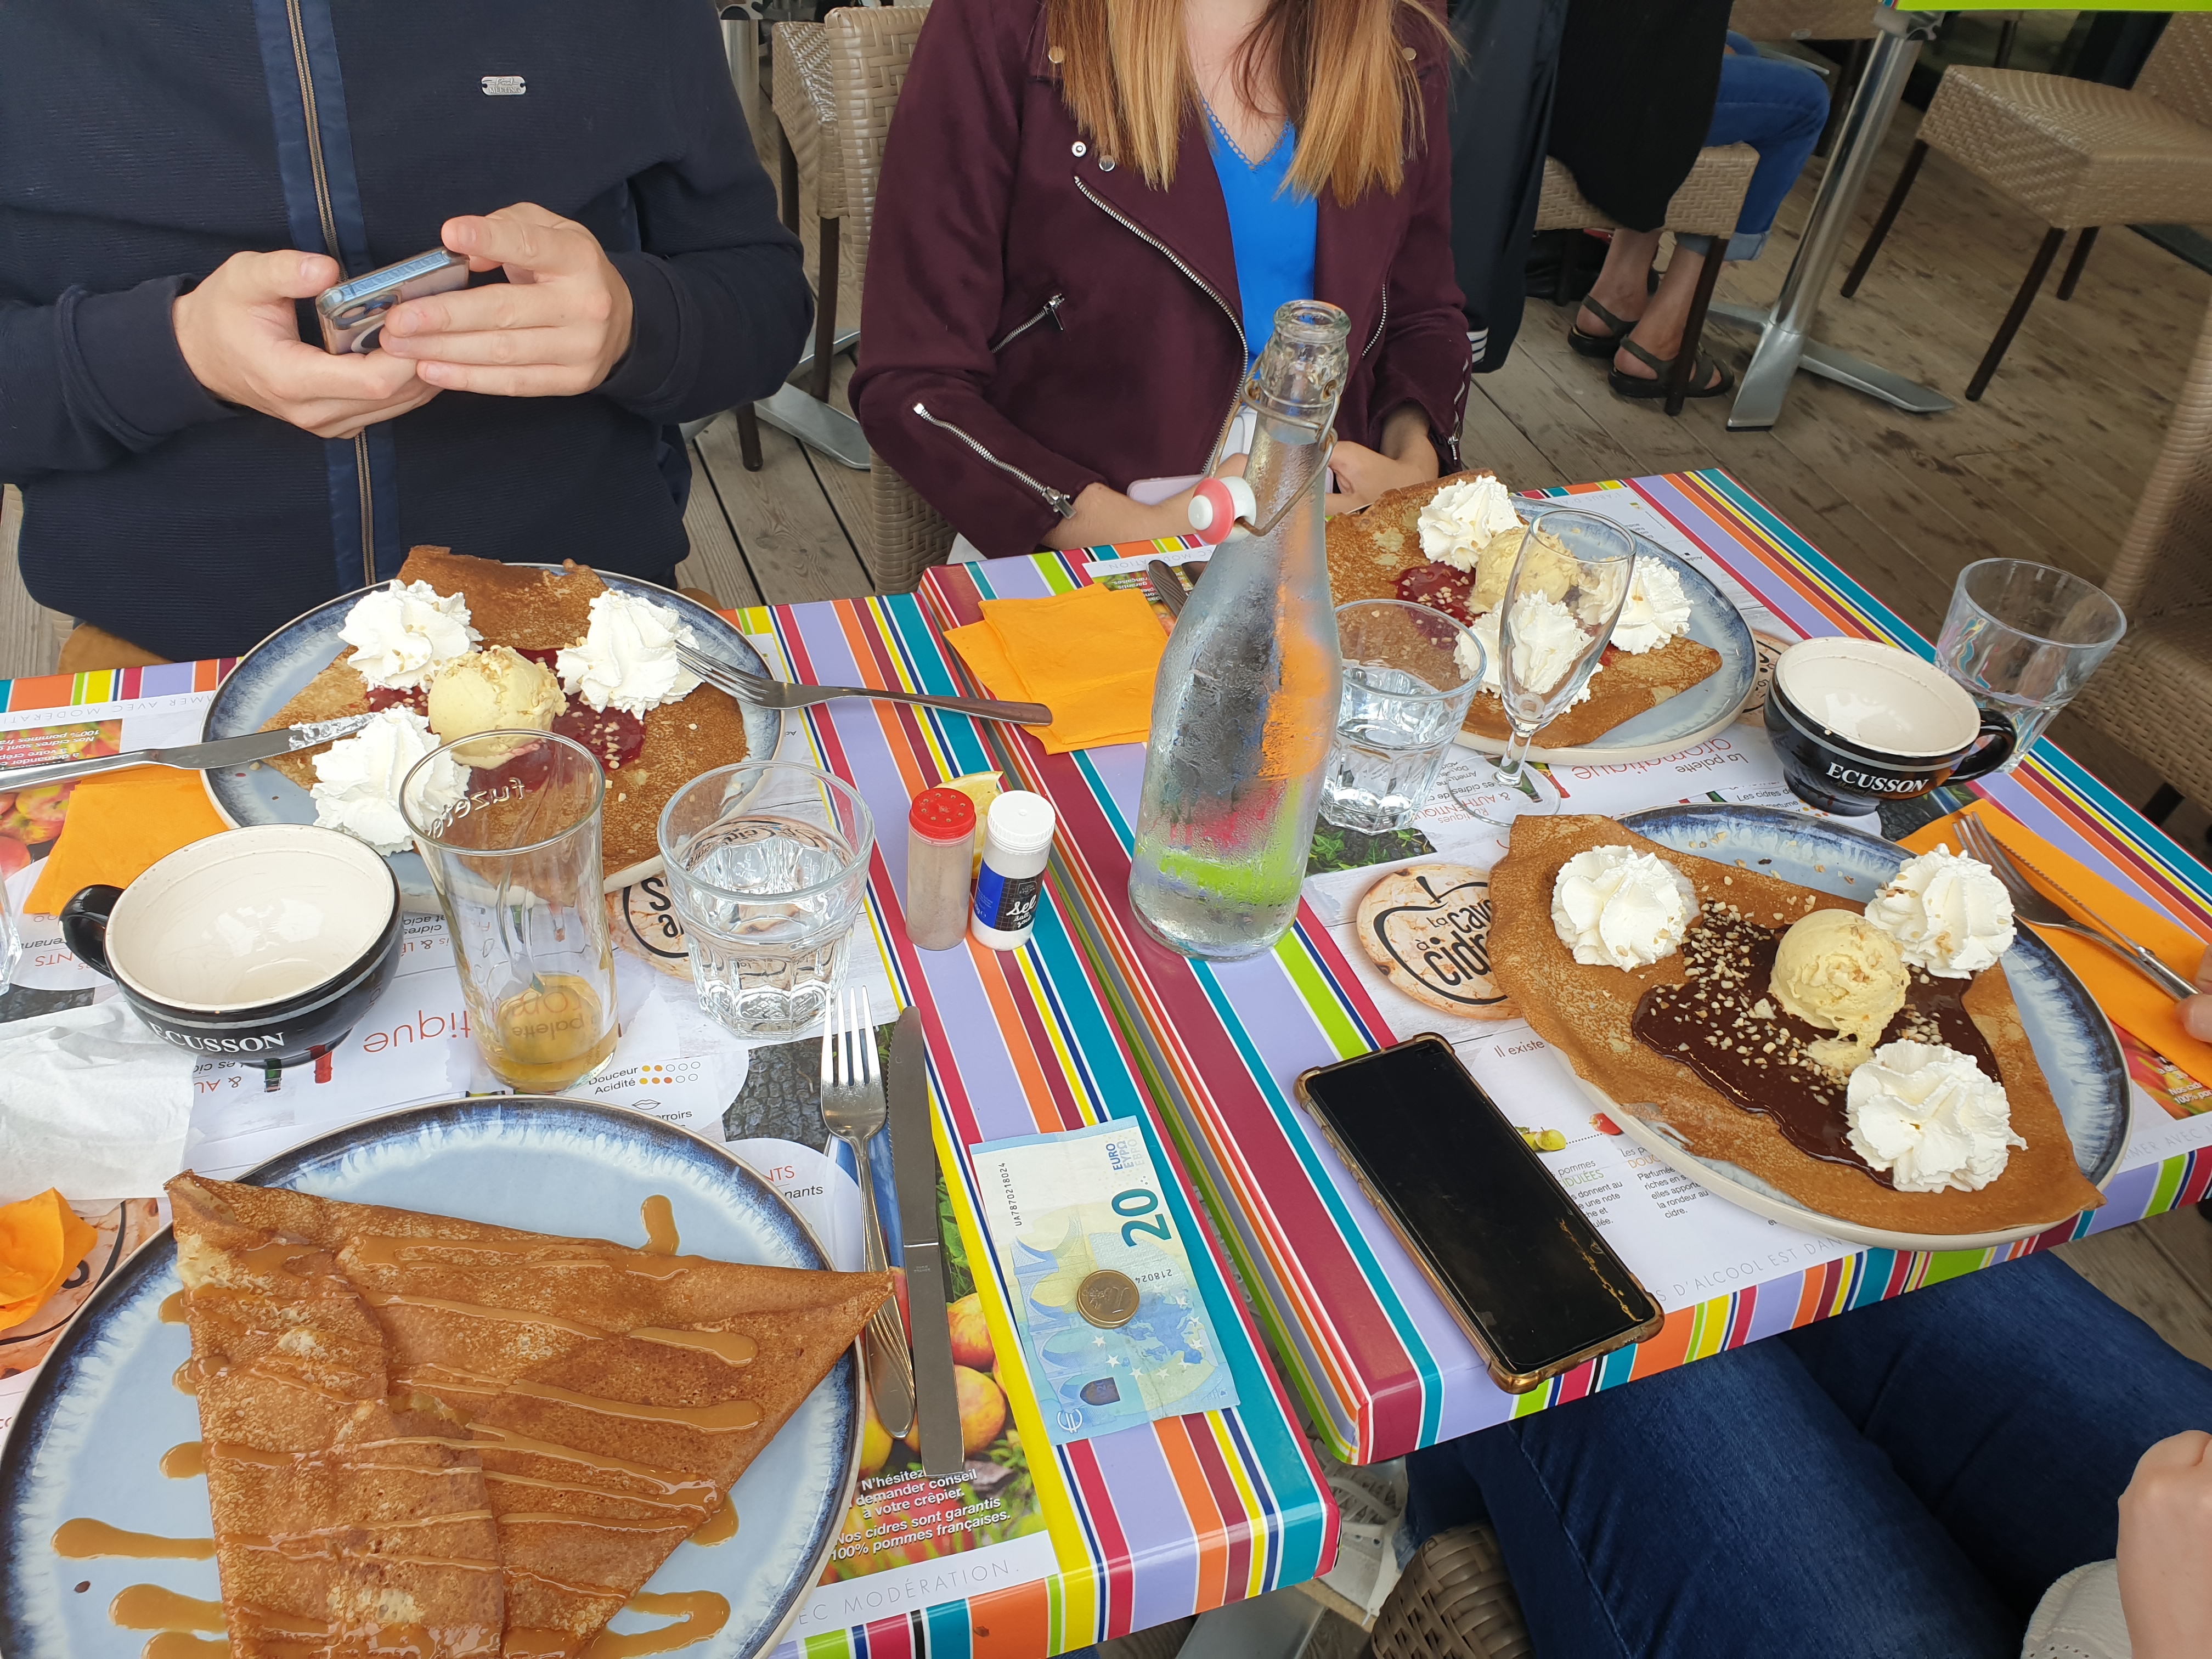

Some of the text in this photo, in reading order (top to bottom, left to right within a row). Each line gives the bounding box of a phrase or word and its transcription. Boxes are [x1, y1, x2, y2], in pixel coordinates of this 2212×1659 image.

[112, 701, 157, 713] AVEC
[18, 731, 67, 743] pommes
[70, 729, 100, 739] 100%
[5, 736, 95, 752] Nos cidres sont
[29, 748, 57, 757] votre
[10, 753, 70, 767] demander
[1674, 753, 1749, 774] La palette
[1825, 761, 1929, 793] ECUSSON
[1451, 783, 1481, 795] cidres
[1736, 793, 1754, 802] Les
[1756, 789, 1781, 798] cidres
[1006, 894, 1037, 916] Sel
[148, 1020, 285, 1053] ECUSSON
[1508, 1040, 1545, 1056] existe
[589, 1066, 639, 1085] Douceur
[594, 1077, 636, 1095] Acidité
[2168, 1086, 2187, 1096] Nos
[2173, 1093, 2198, 1104] 100%
[2164, 1128, 2203, 1147] AVEC
[1105, 1142, 1123, 1171] EURO
[1620, 1147, 1636, 1158] Les
[1558, 1160, 1596, 1178] pommes
[1577, 1184, 1612, 1199] donnent
[1612, 1181, 1623, 1189] au
[1644, 1178, 1669, 1190] riches
[998, 1161, 1023, 1227] UA7870218024
[1585, 1199, 1602, 1208] une
[1602, 1192, 1621, 1203] note
[1651, 1188, 1670, 1200] elles
[1656, 1189, 1709, 1210] la rondeur au
[1111, 1187, 1173, 1248] 20
[1599, 1207, 1609, 1215] et
[1664, 1207, 1688, 1219] cidre.
[1135, 1268, 1173, 1284] 218024
[1673, 1259, 1763, 1297] D'ALCOOL
[1767, 1248, 1798, 1267] EST
[856, 1468, 978, 1508] demander conseil
[862, 1486, 965, 1520] à votre crêpier.
[836, 1497, 1002, 1547] Nos cidres sont garantis
[830, 1509, 1012, 1563] 100% pommes françaises.
[844, 1559, 1019, 1615] MODÉRATION.
